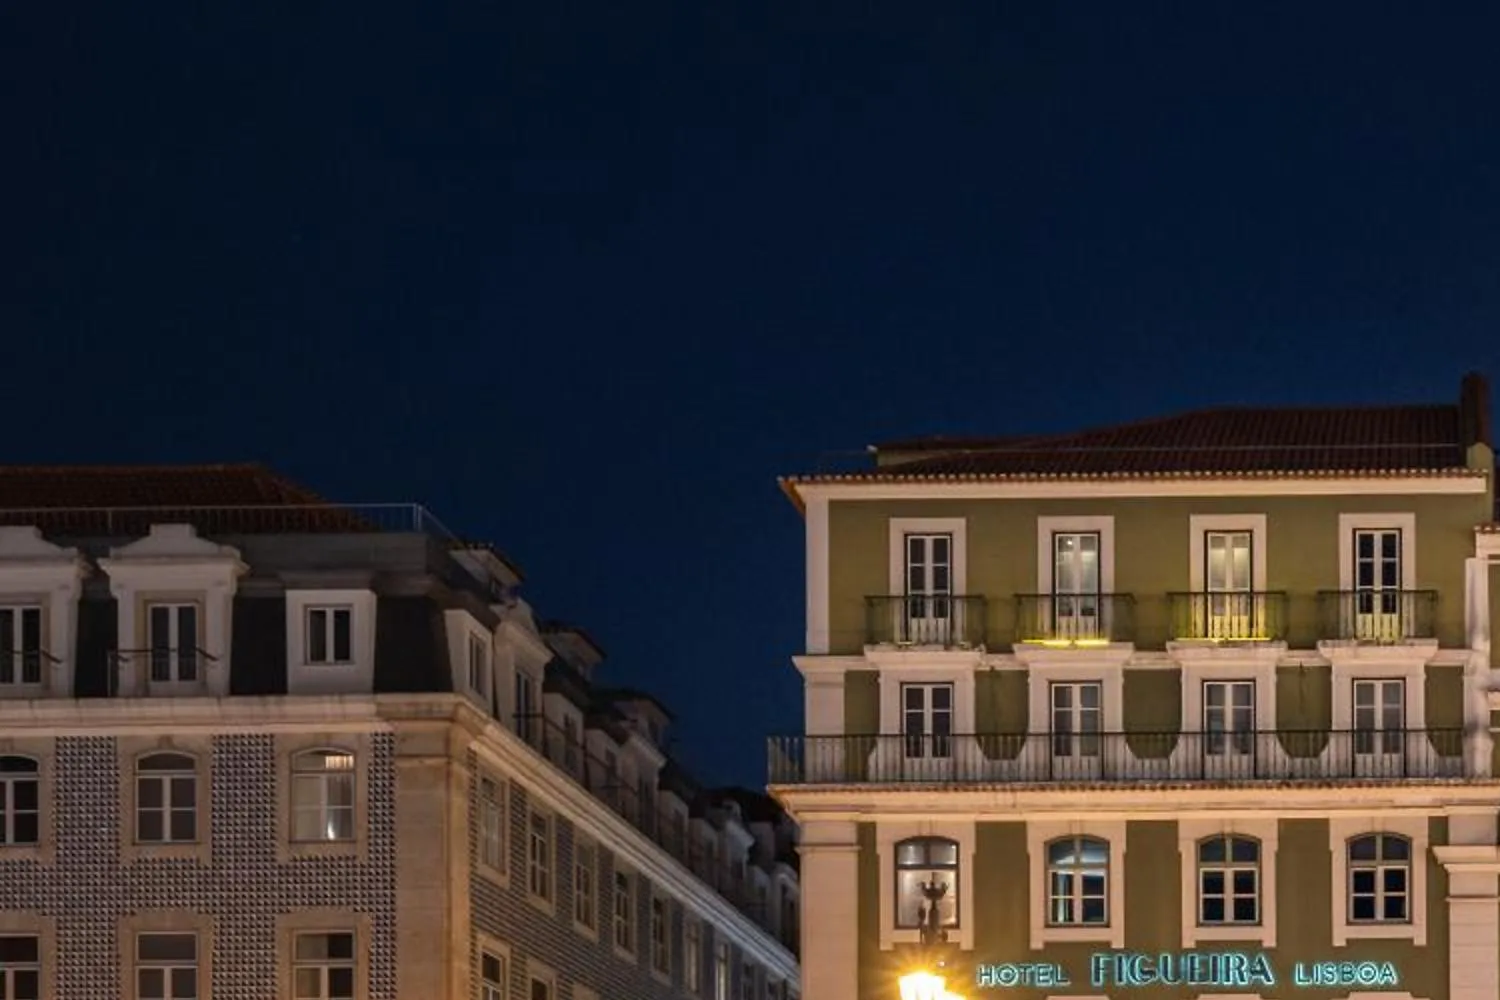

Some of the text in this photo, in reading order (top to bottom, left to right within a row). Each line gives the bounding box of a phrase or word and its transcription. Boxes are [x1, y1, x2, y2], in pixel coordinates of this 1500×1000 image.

[976, 953, 1398, 987] HOTEL FIGUEIRA LISBOA
